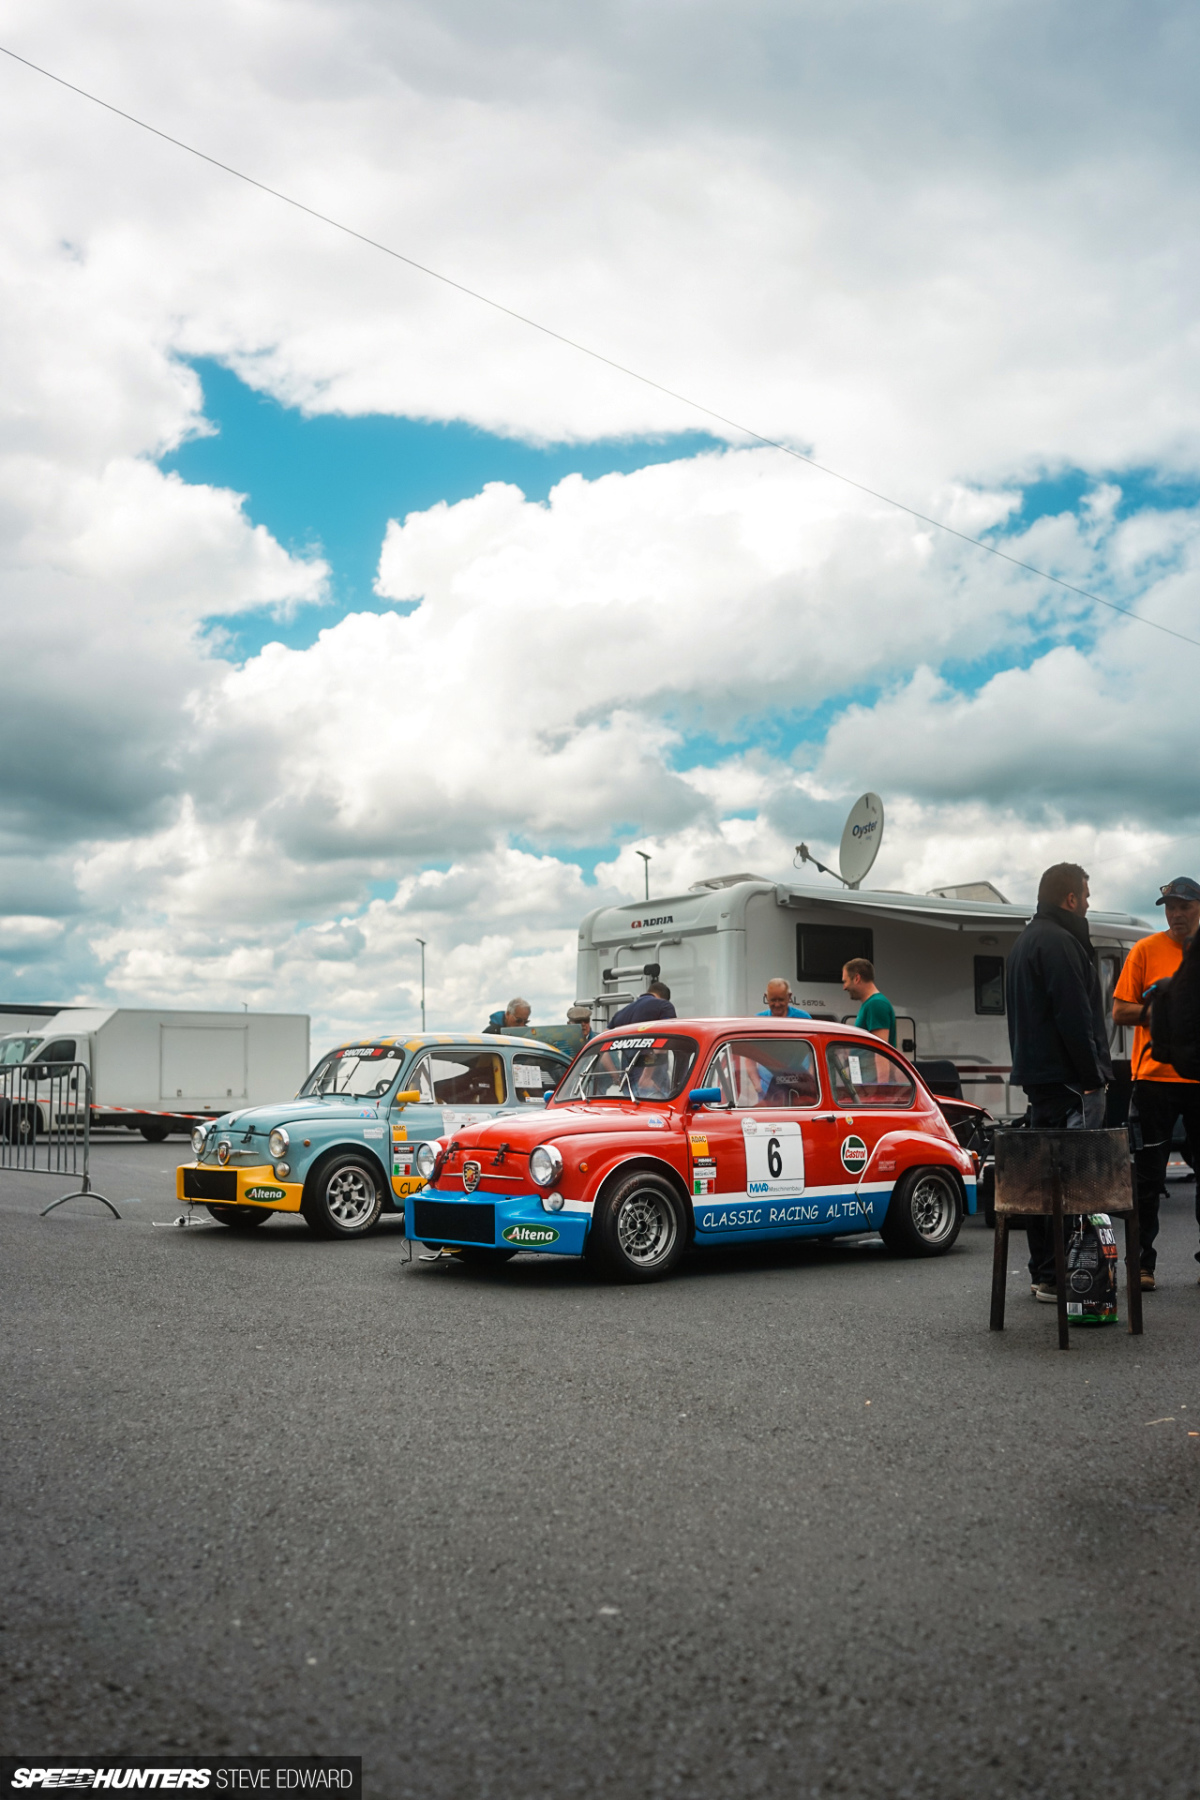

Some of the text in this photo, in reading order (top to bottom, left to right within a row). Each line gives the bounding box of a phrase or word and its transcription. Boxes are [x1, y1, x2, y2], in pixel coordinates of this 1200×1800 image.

[852, 821, 878, 839] Oyster
[643, 915, 673, 927] ADRIA
[609, 1038, 655, 1050] SANDTLER
[691, 1135, 707, 1143] ADAC
[767, 1138, 782, 1178] 6
[845, 1149, 866, 1159] Castrol
[248, 1188, 283, 1198] Altena
[702, 1201, 874, 1228] CLASSIC RACING ALTENA
[507, 1226, 554, 1241] Altena
